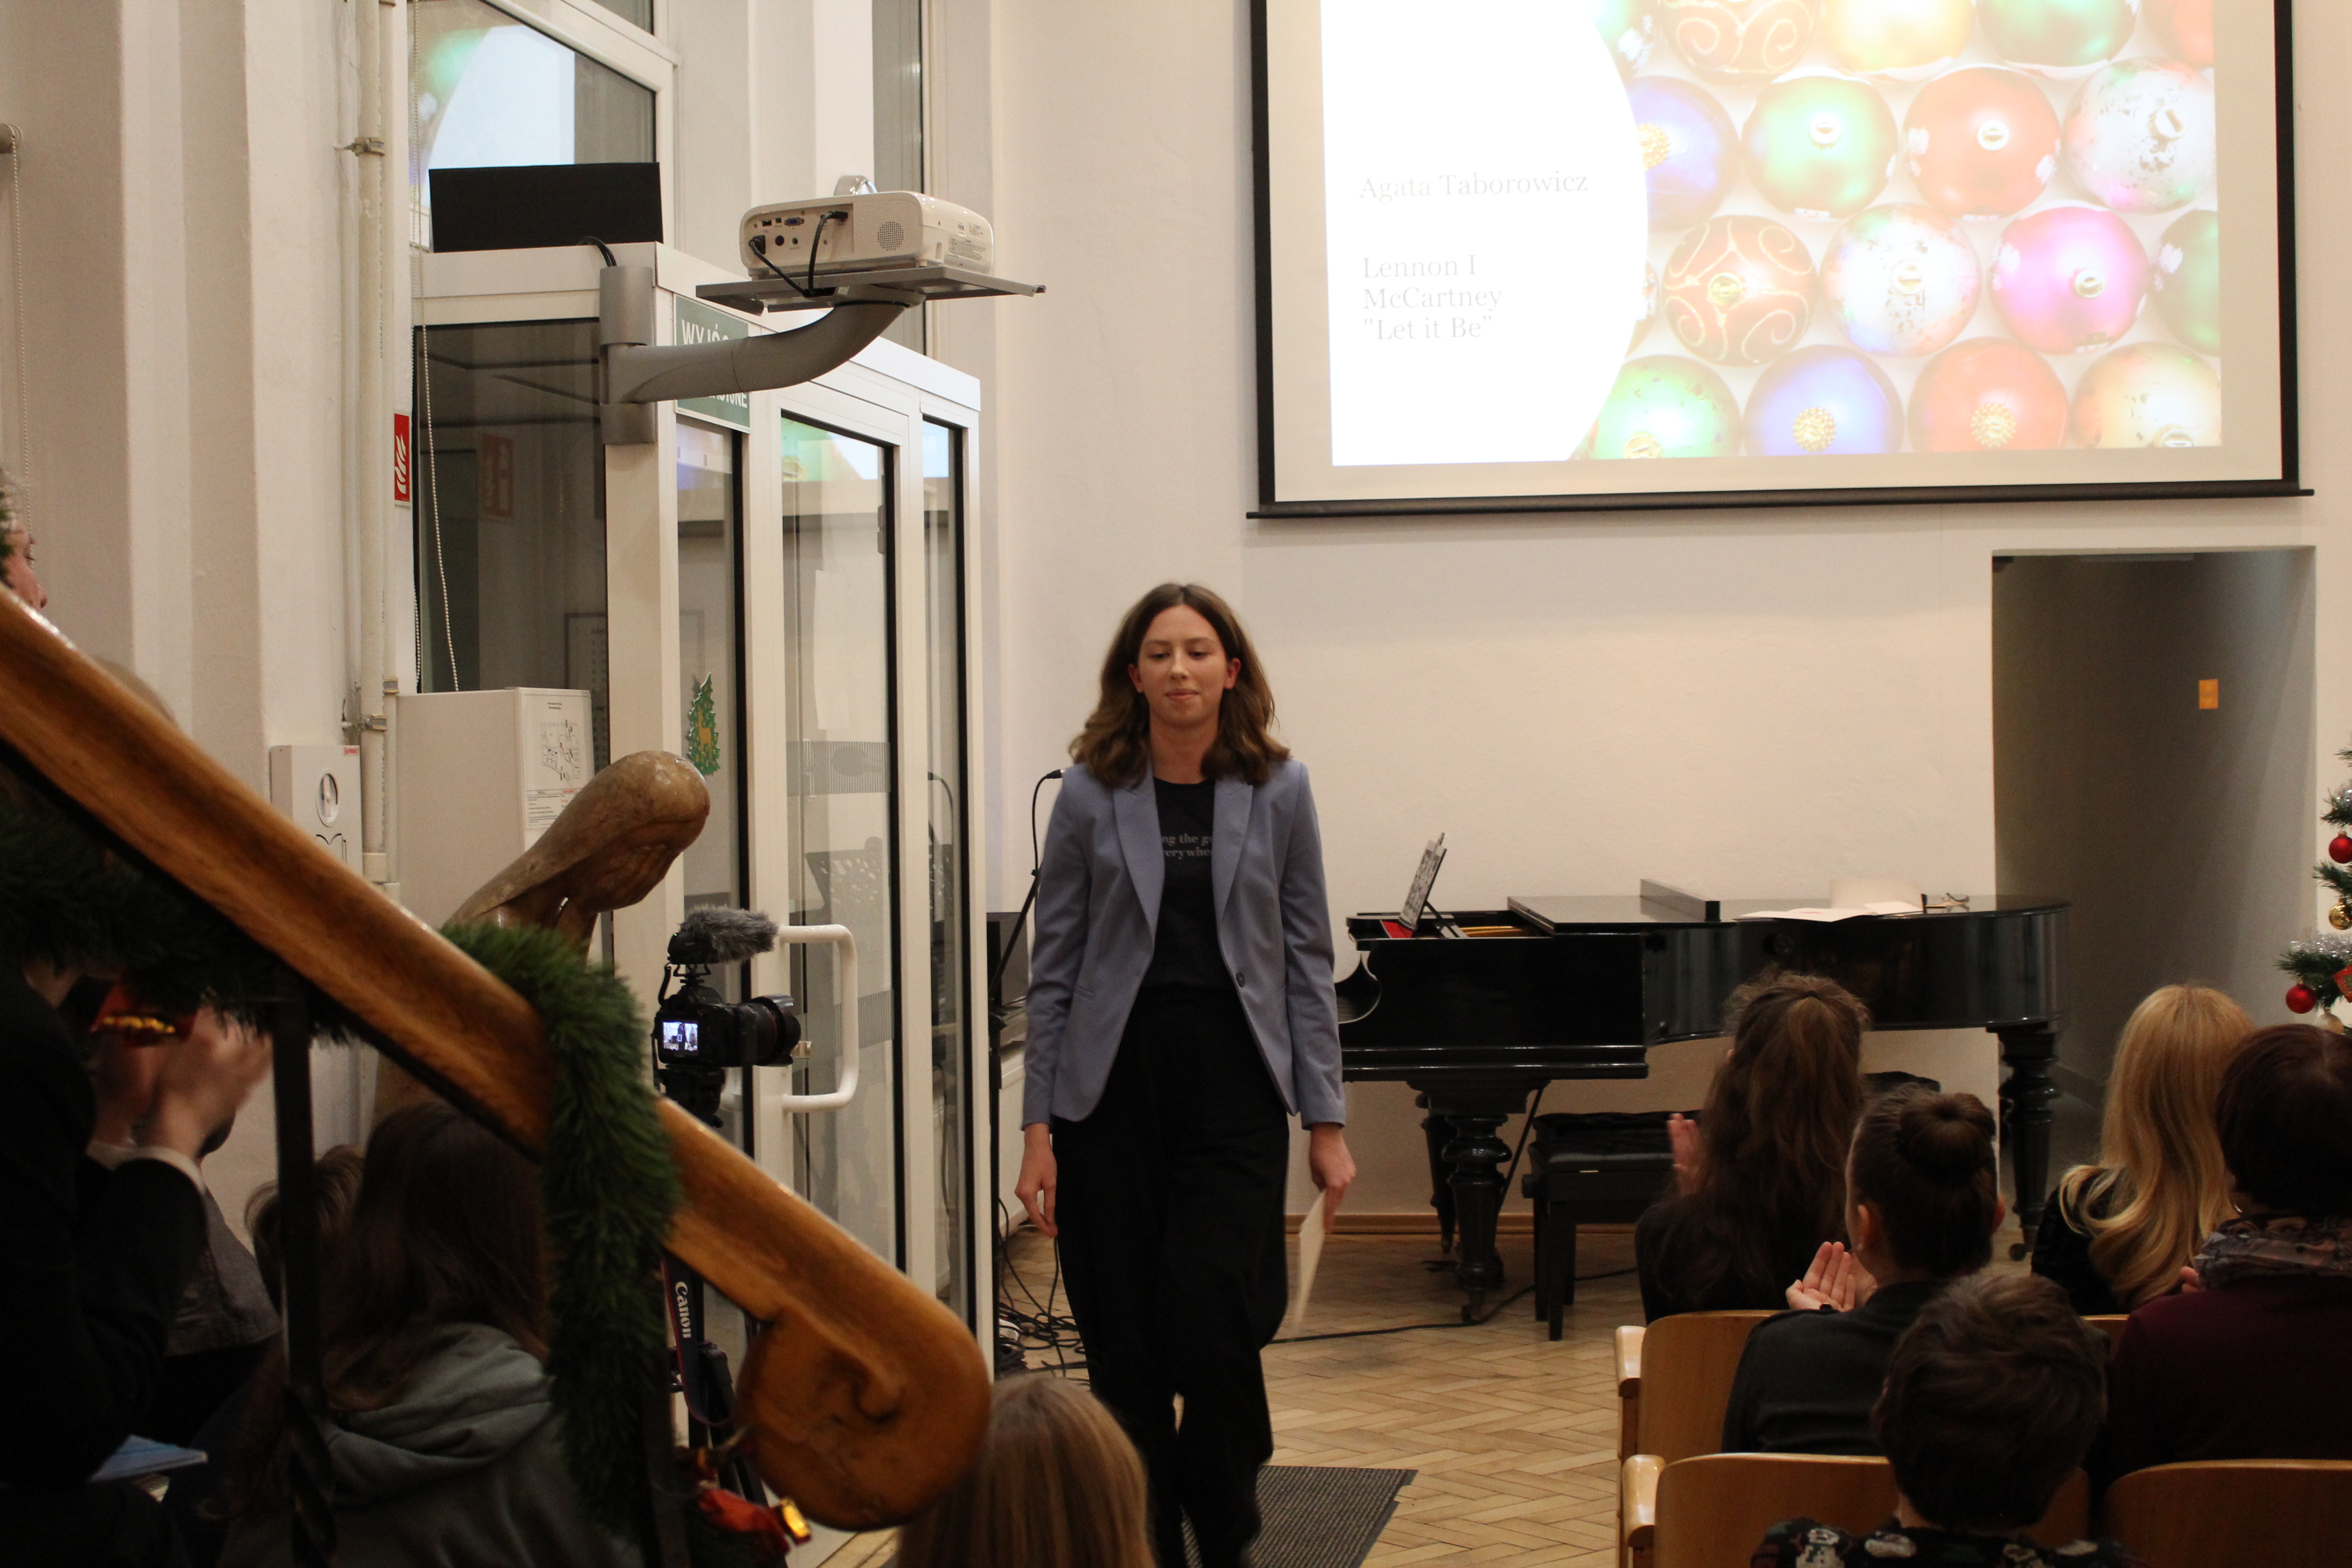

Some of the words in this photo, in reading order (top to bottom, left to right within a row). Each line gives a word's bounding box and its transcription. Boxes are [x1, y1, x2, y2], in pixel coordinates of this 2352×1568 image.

[1359, 177, 1432, 203] Agata
[1439, 170, 1589, 196] Taborowicz
[1362, 258, 1459, 278] Lennon
[1468, 255, 1477, 275] I
[1363, 287, 1503, 312] McCartney
[1364, 318, 1416, 340] "Let
[1425, 317, 1441, 338] it
[1451, 314, 1492, 338] Be"
[1179, 833, 1198, 843] the
[675, 1281, 692, 1338] Canon
